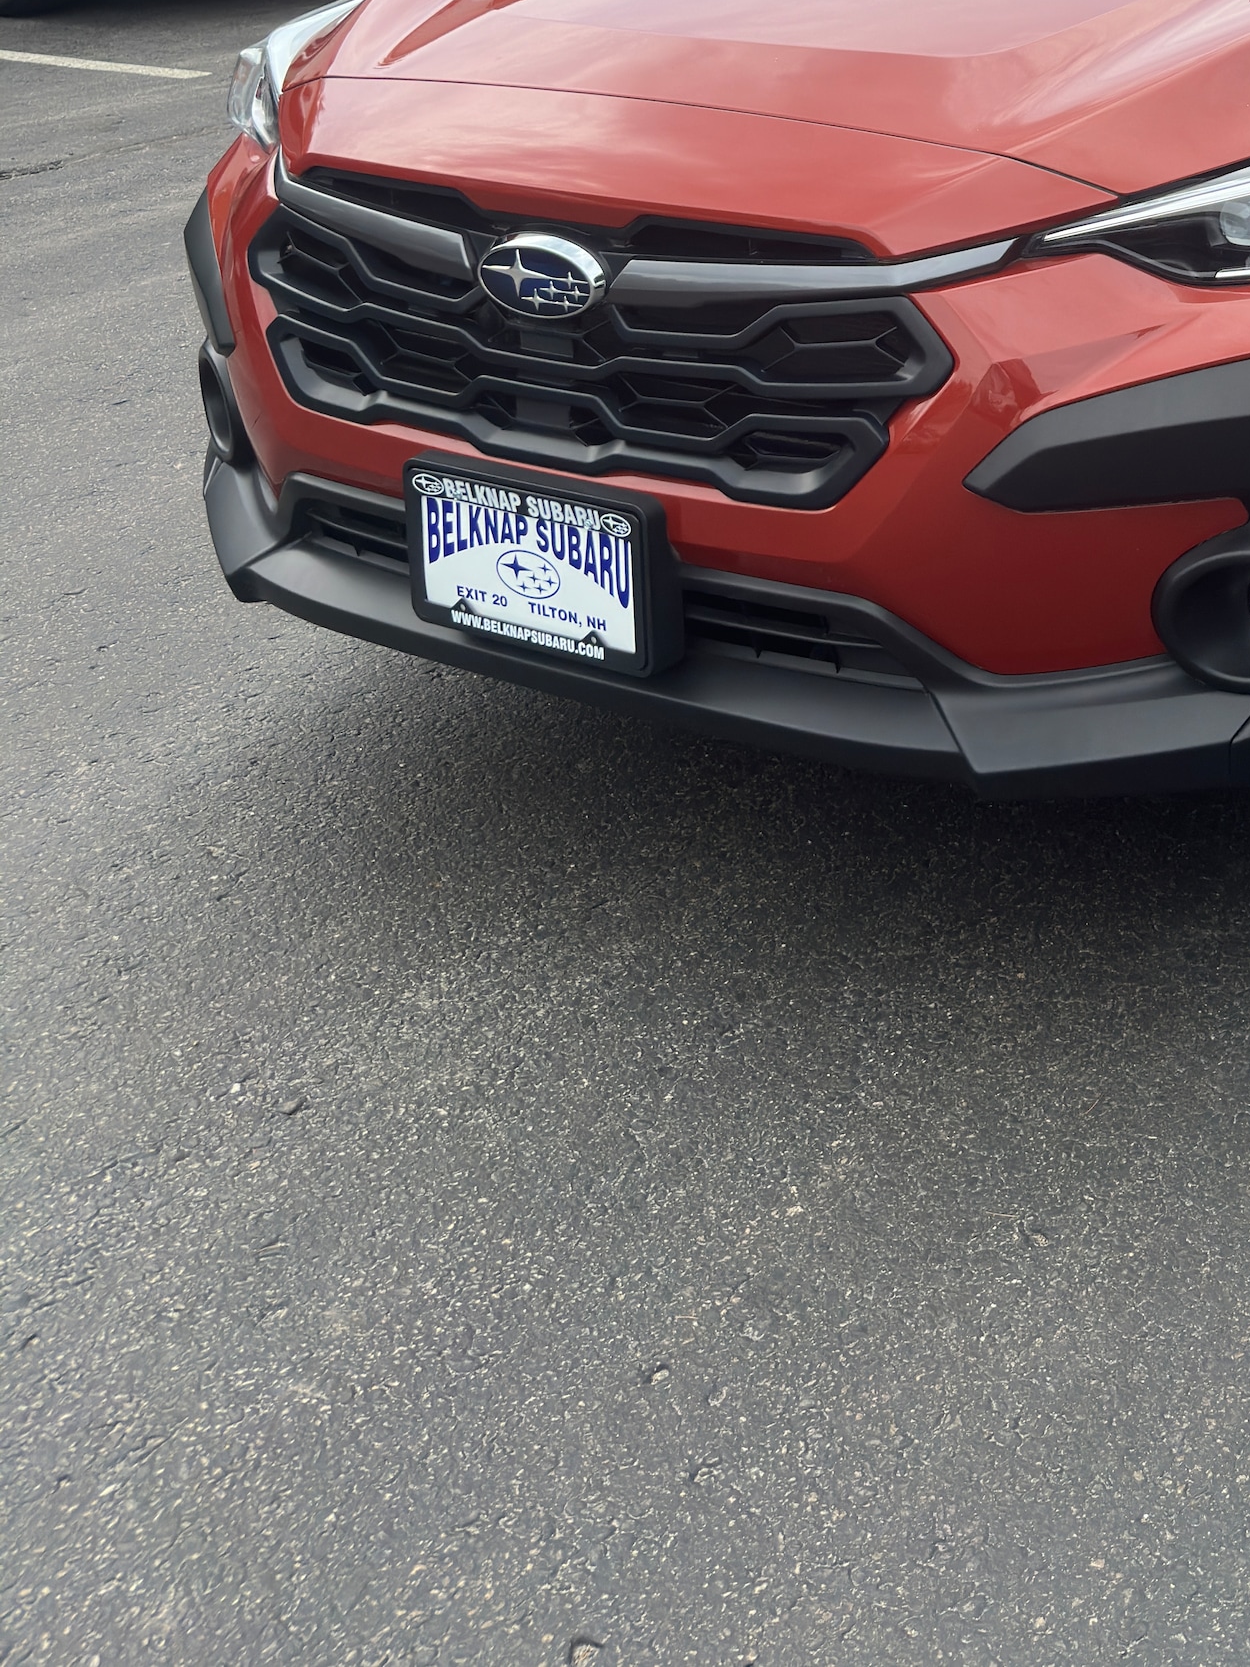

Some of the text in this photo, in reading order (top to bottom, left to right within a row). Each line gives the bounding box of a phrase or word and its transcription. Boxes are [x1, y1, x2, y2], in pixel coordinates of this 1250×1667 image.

[443, 477, 601, 531] BELKNAP SUBARU
[427, 497, 632, 609] BELKNAP SUBARU
[456, 585, 607, 631] EXIT 20 TILTON, NH
[451, 610, 605, 660] WWW.BELKNAPSUBARU.COM
